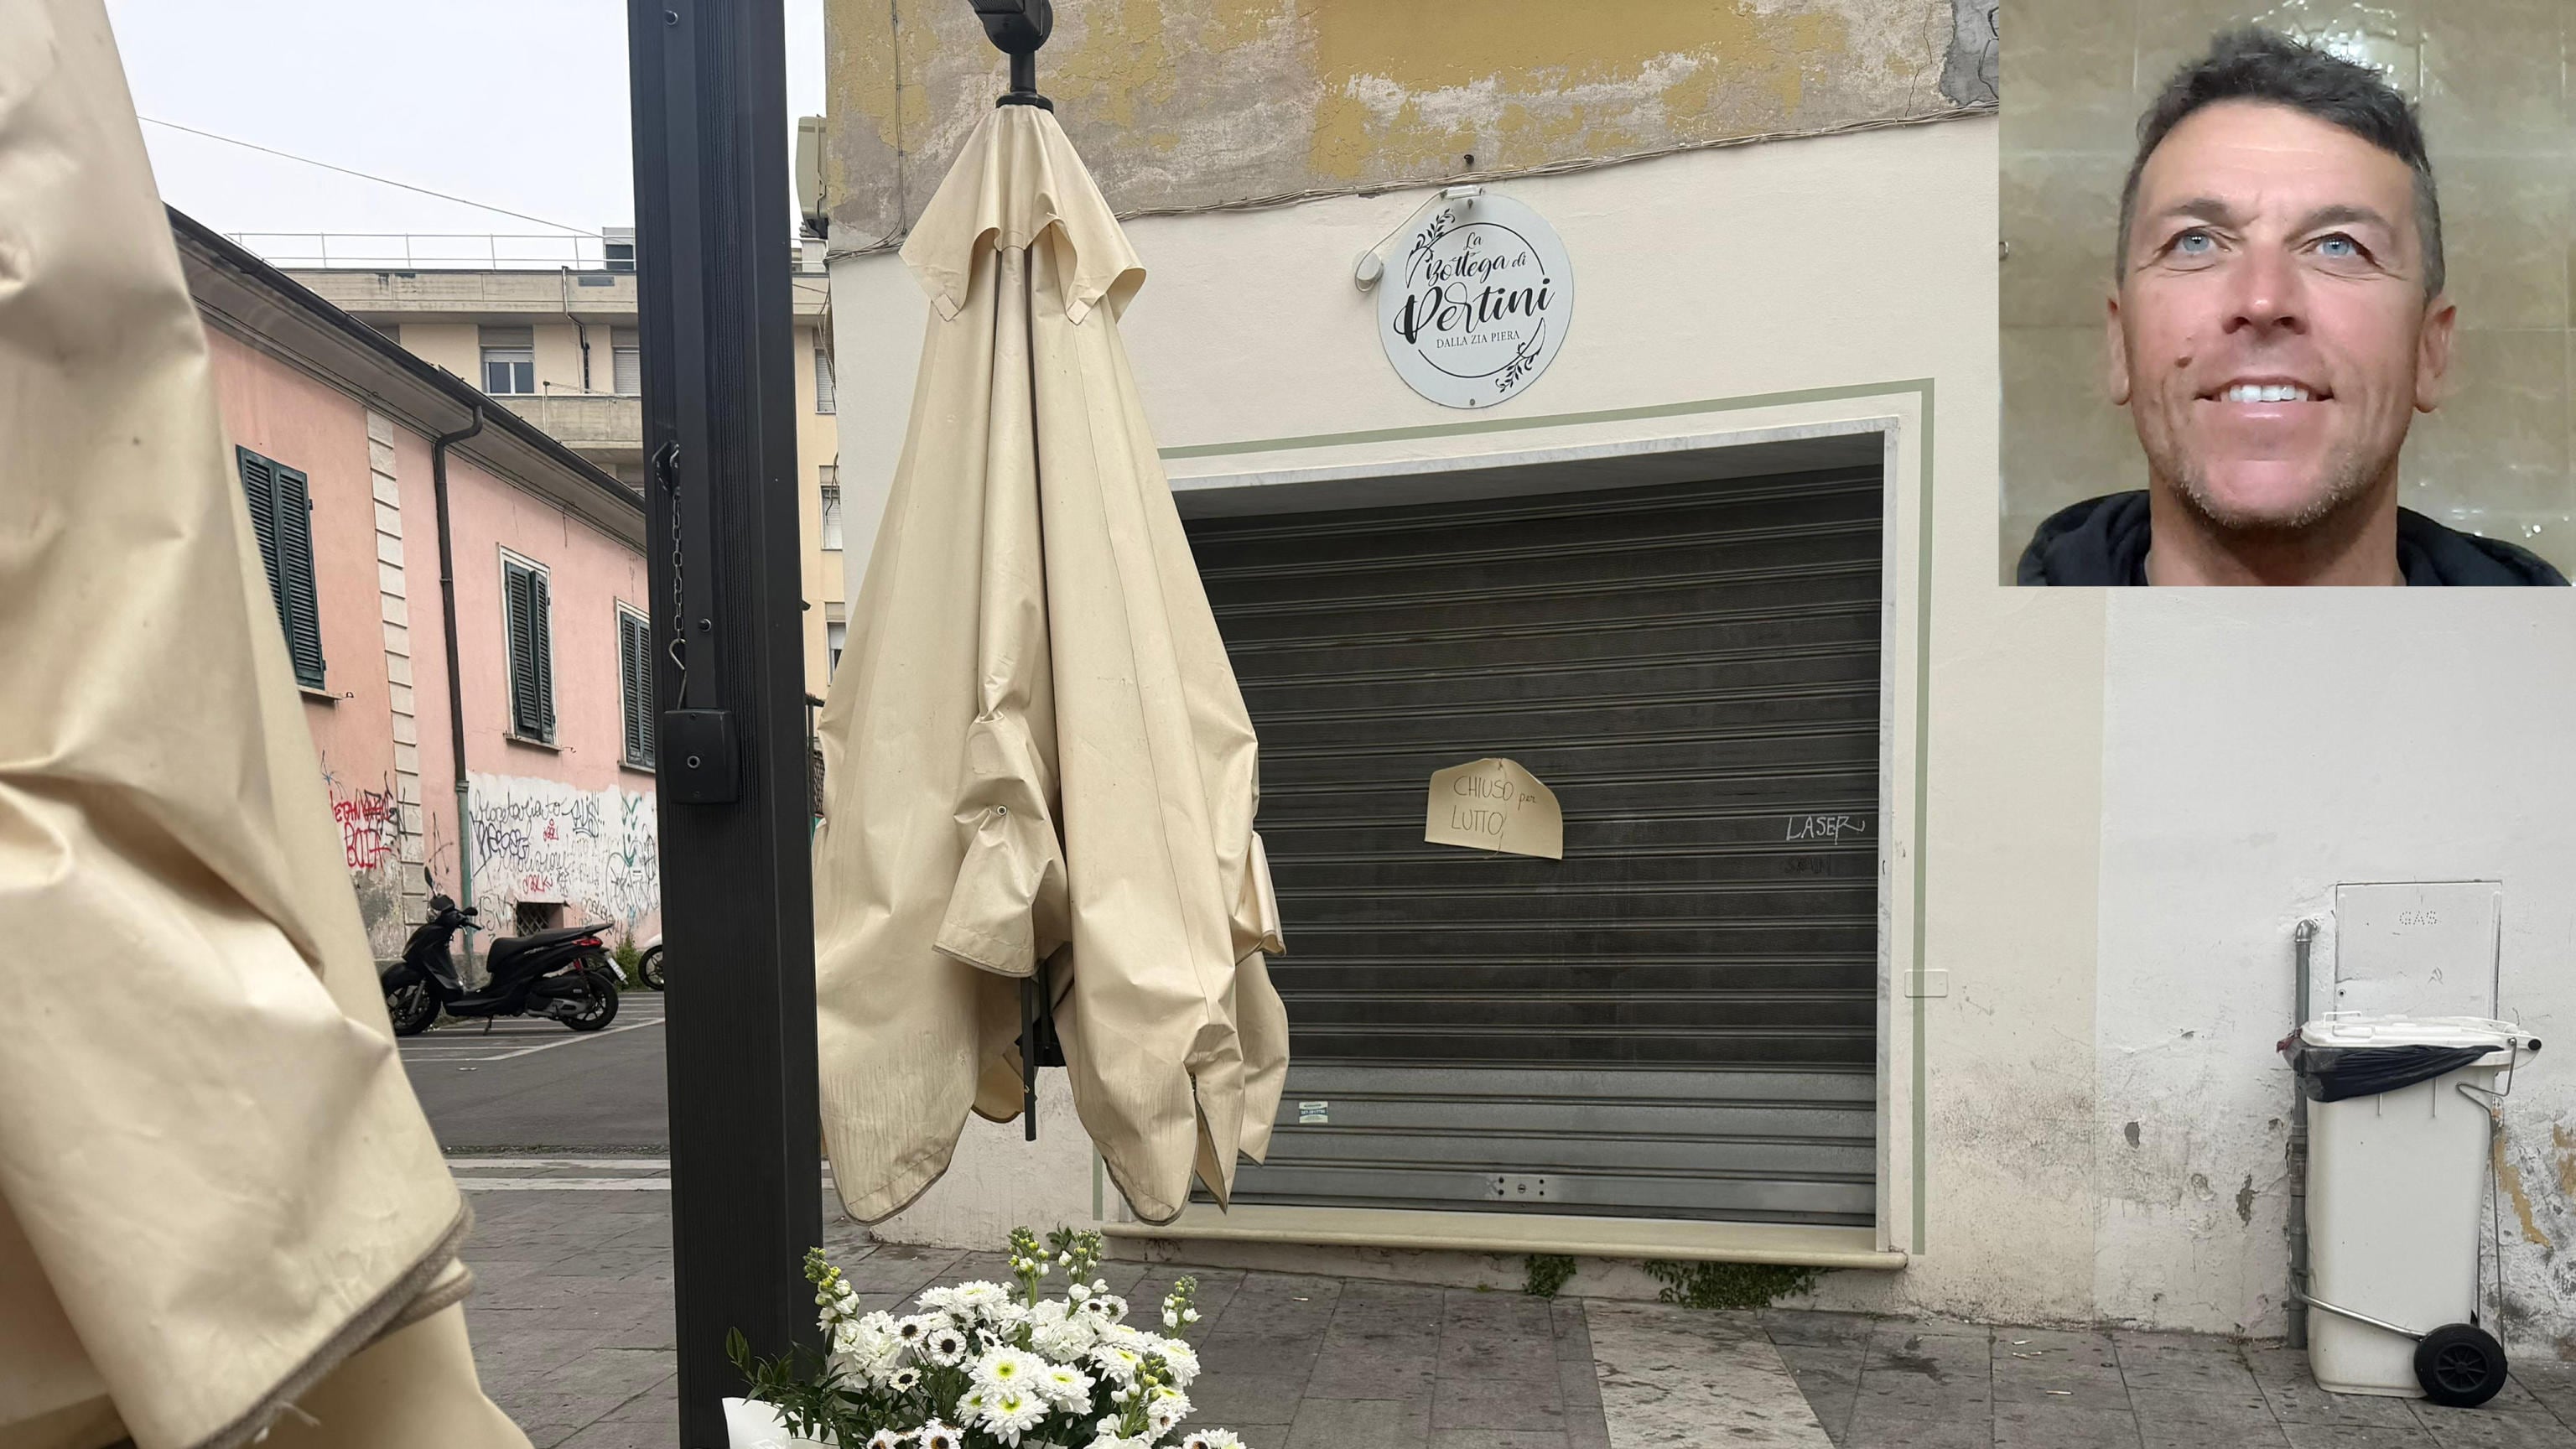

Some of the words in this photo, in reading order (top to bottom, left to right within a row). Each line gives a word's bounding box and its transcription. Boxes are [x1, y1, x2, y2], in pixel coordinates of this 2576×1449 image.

[1463, 231, 1482, 251] La
[1426, 251, 1509, 287] Bottega
[1511, 251, 1526, 267] di
[1394, 278, 1555, 344] Pertini
[1436, 336, 1467, 349] DALLA
[1471, 335, 1488, 345] ZIA
[1491, 330, 1520, 342] PIERA
[1453, 775, 1514, 802] CHIUSO
[1518, 792, 1537, 811] per
[1451, 805, 1504, 835] LUTTO
[1786, 815, 1866, 845] LASER
[2399, 911, 2438, 926] GAS
